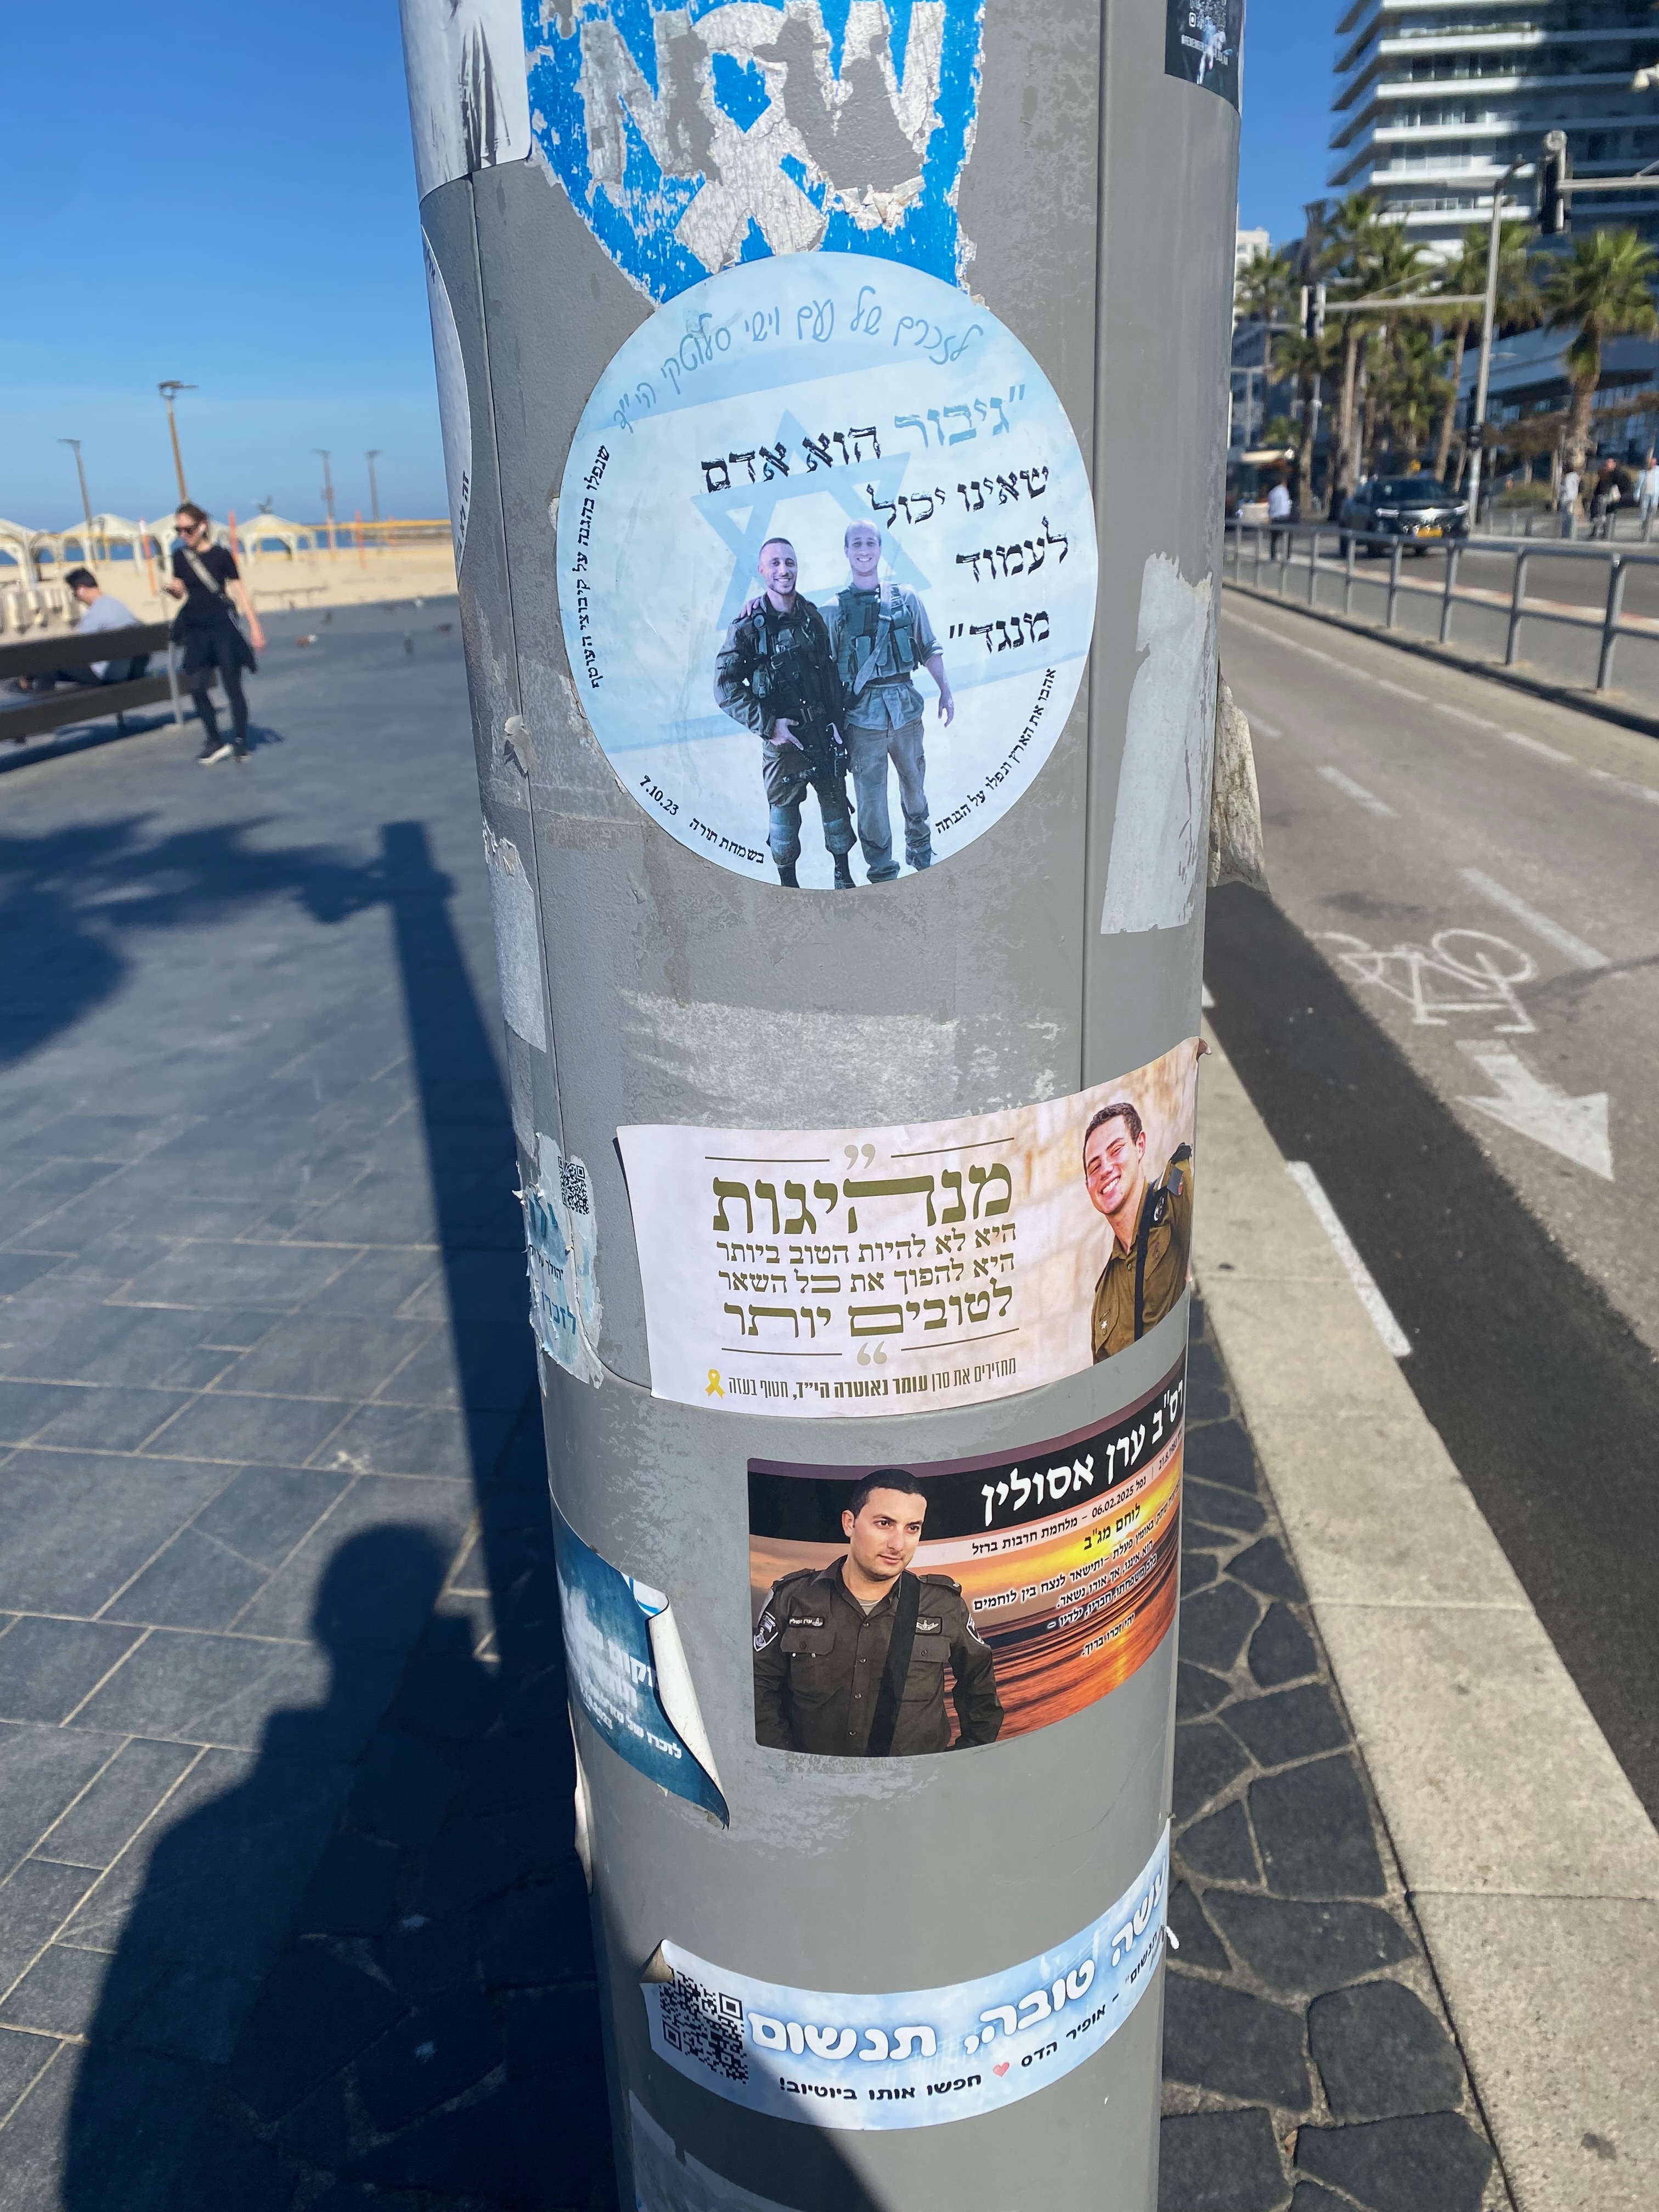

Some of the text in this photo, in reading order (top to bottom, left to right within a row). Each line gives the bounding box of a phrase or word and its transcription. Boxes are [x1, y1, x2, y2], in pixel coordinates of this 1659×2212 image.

[745, 307, 780, 341] וישי
[850, 286, 882, 335] של
[894, 316, 983, 365] לזכרם
[802, 426, 881, 473] הוא
[701, 441, 790, 493] אדם
[866, 465, 1050, 529] שאינו יכול
[956, 516, 1069, 583] לעמוד
[572, 444, 610, 689] שנפלו בהגנה על קיבוצי העוטף
[935, 668, 1056, 834] אהבו את הארץ ונפלו על הגנתה
[640, 775, 764, 864] בשמחת תורה 7.10.23
[713, 1163, 1012, 1234] מנהיגות
[716, 1222, 1017, 1264] היא לא להיות הטוב ביותר
[718, 1251, 1015, 1295] היא להפוך את כל השאר
[723, 1278, 1013, 1339] לטובים יותר
[892, 1374, 928, 1394] עומר
[931, 1371, 950, 1392] סרן
[953, 1367, 970, 1386] את
[973, 1357, 1017, 1383] מחזירים
[727, 1376, 758, 1396] בעזה
[760, 1380, 788, 1398] חטוף
[833, 1378, 888, 1398] נאוטרה
[1105, 1424, 1146, 1485] ערן
[980, 1453, 1094, 1527] אסולין
[1135, 1476, 1147, 1492] נפל
[1091, 1484, 1134, 1519] 06.02.2025
[1041, 1517, 1077, 1539] מלחמת
[1115, 1503, 1141, 1533] לוחם
[972, 1542, 998, 1556] ברזל
[1002, 1531, 1037, 1549] חרבות
[1041, 1575, 1065, 1593] לנצח
[1110, 1567, 1120, 1582] אך
[974, 1589, 1017, 1611] לוחמים
[1022, 1585, 1036, 1601] בין
[1057, 1587, 1085, 1607] נשאר.
[963, 1959, 1096, 2055] טובה,
[1066, 2004, 1105, 2040] אופיר
[748, 2011, 936, 2062] תנשום
[1021, 2041, 1058, 2068] הדס
[780, 2078, 857, 2100] ביוטיוב!
[869, 2086, 916, 2101] אותו
[927, 2074, 982, 2096] חפשו
